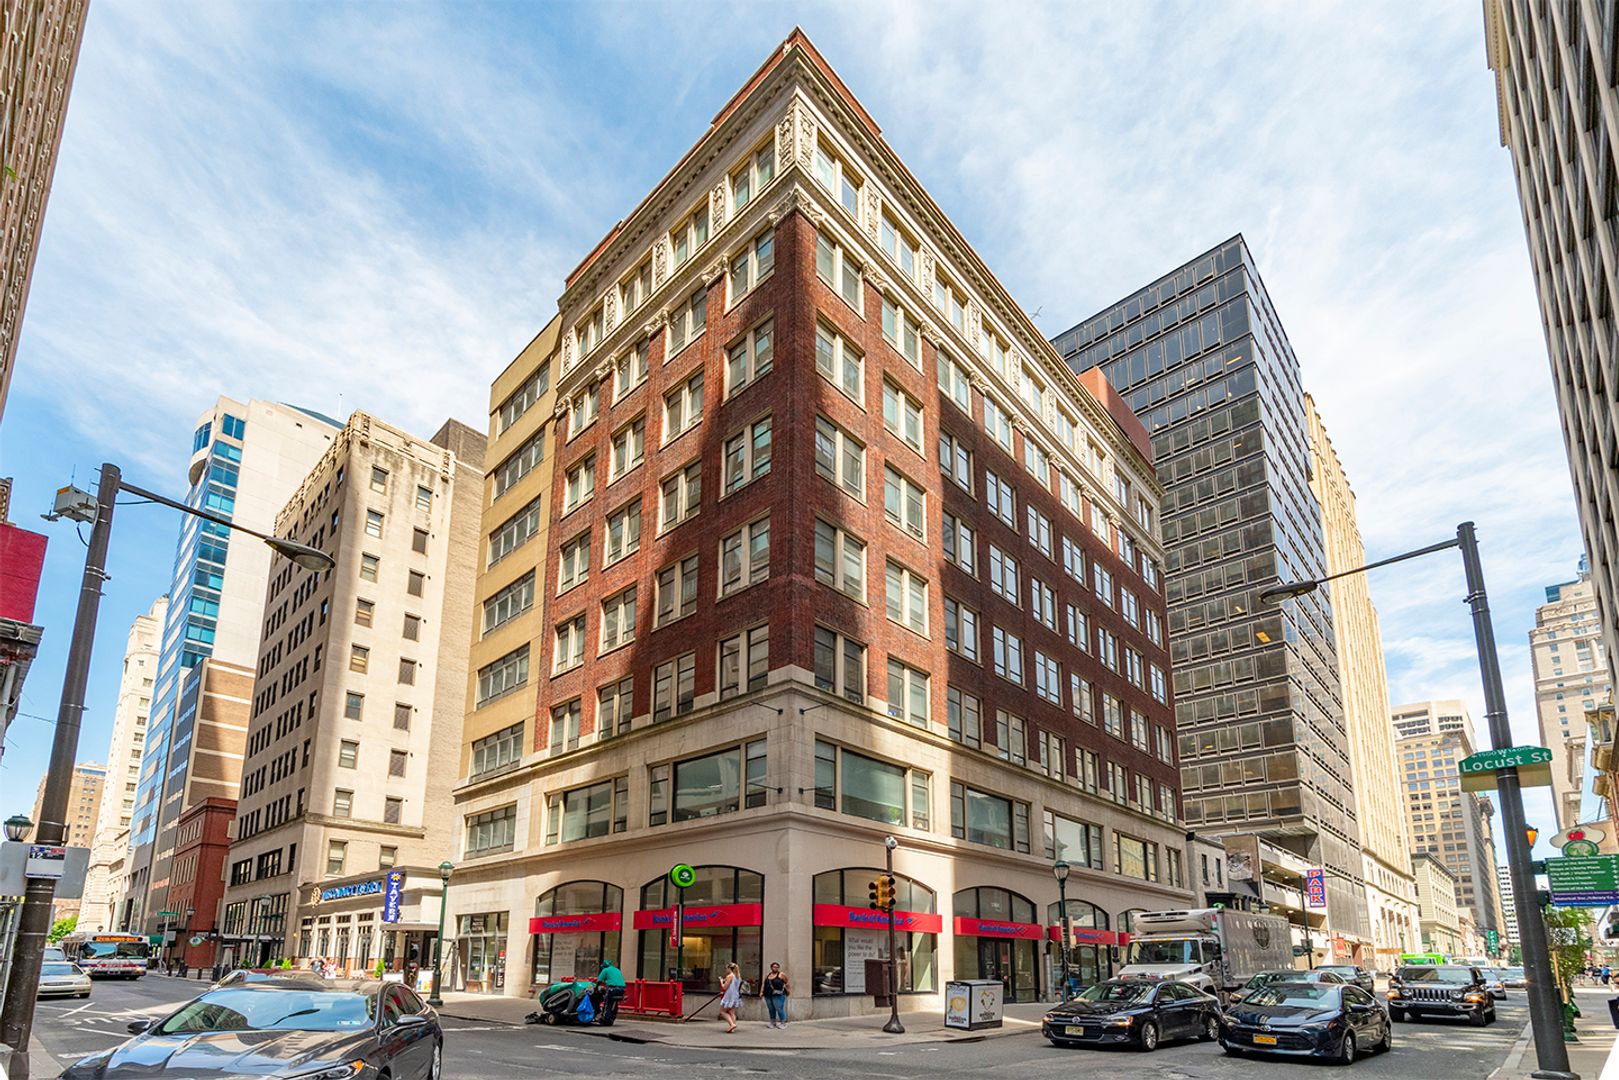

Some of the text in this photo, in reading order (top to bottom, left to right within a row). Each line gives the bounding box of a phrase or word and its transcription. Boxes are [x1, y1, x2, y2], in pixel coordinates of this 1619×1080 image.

[1462, 751, 1550, 772] Locust St
[1309, 870, 1324, 903] PARK
[543, 920, 554, 928] Bank
[559, 919, 581, 927] America
[652, 911, 707, 923] Bank merica
[849, 911, 904, 925] Bank of Ameica
[978, 922, 991, 931] Bank
